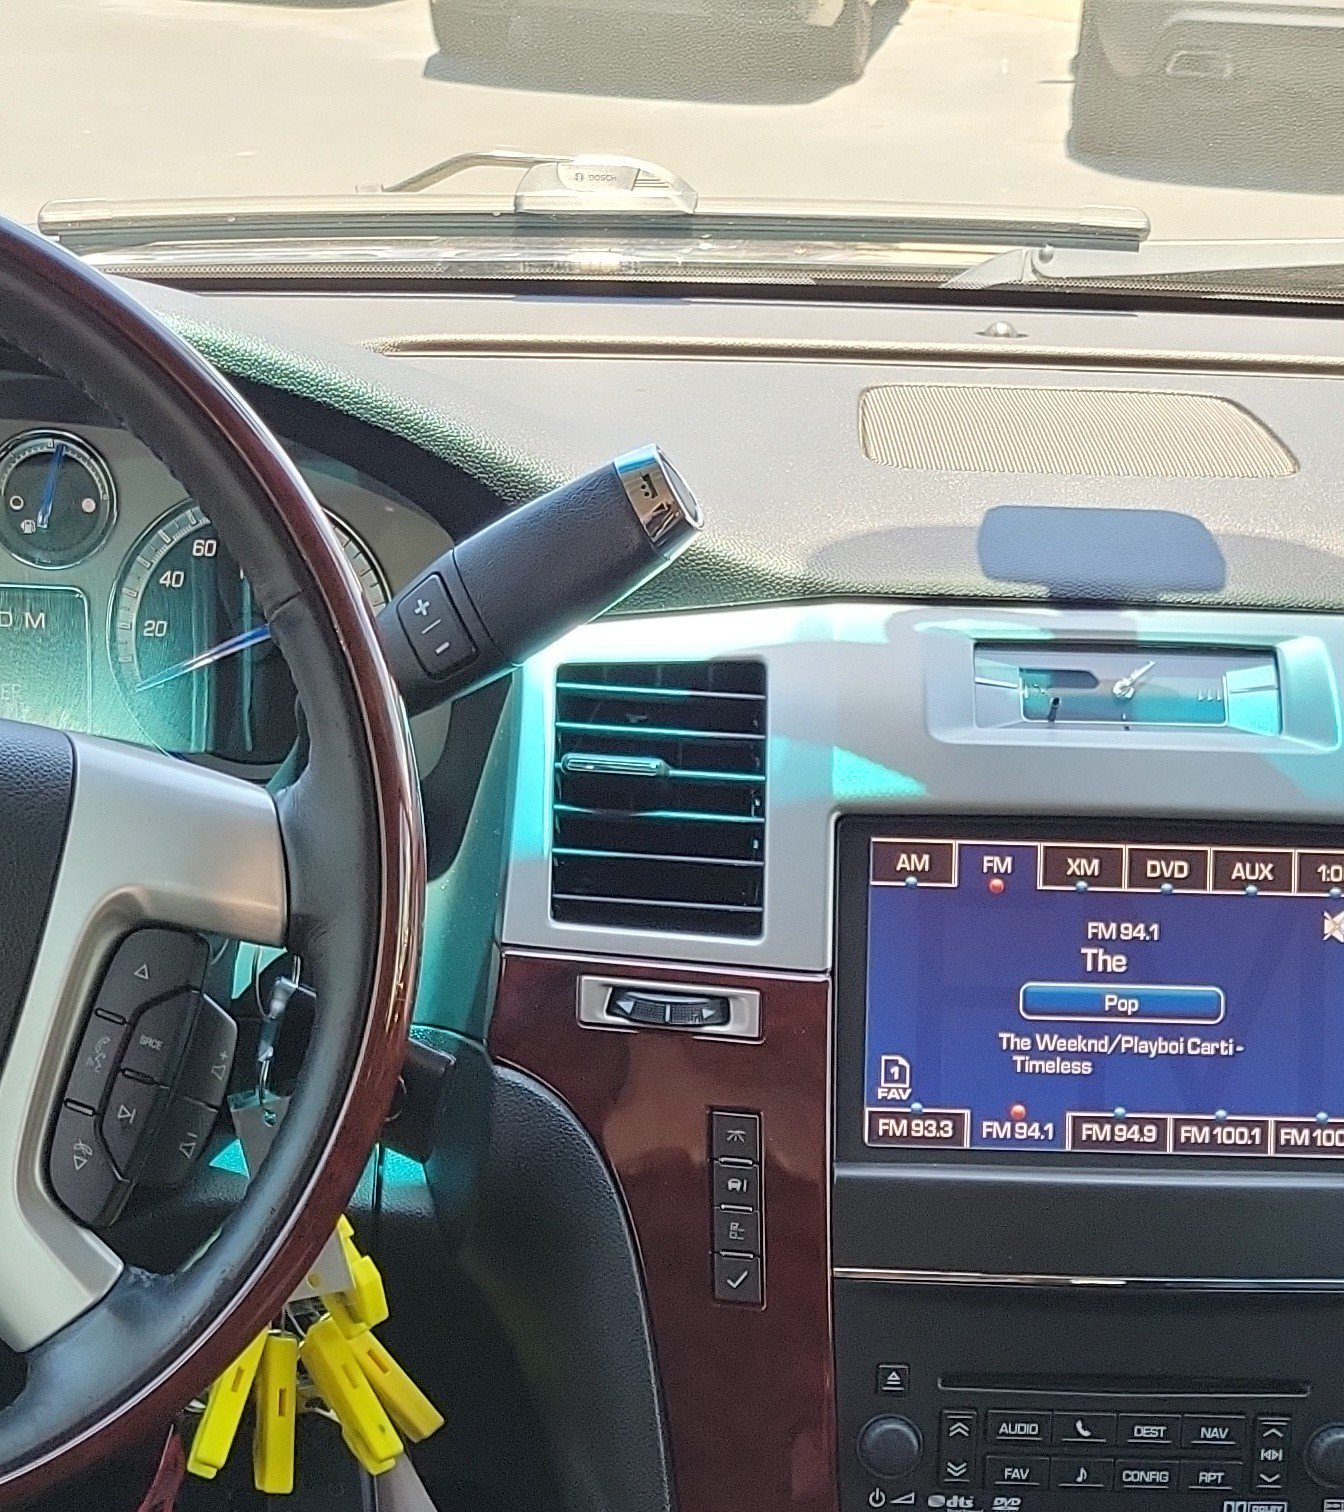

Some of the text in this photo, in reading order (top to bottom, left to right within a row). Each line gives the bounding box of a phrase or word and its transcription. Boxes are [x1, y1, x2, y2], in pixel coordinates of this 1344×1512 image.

[192, 539, 217, 557] 60
[159, 570, 185, 588] 40
[25, 612, 45, 629] M
[143, 620, 168, 637] 20
[896, 853, 930, 872] AM
[983, 856, 1013, 874] FM
[1066, 858, 1100, 876] XM
[1147, 860, 1189, 879] DVD
[1231, 862, 1274, 881] AUX
[1087, 922, 1160, 941] FM 94.1
[1081, 948, 1128, 972] The
[1105, 994, 1138, 1015] Pop
[999, 1032, 1032, 1051] The
[1035, 1033, 1184, 1058] Weeknd/Playboi
[1187, 1037, 1234, 1056] Carti
[890, 1066, 900, 1080] 1
[1013, 1056, 1093, 1075] Timeless
[877, 1088, 912, 1100] FAV
[878, 1119, 953, 1138] FM 93.3
[982, 1121, 1054, 1141] FM 94.1
[1081, 1123, 1157, 1143] FM 94.9
[1180, 1126, 1262, 1145] FM 100.1
[1280, 1128, 1310, 1146] FM
[998, 1422, 1039, 1435] AUDIO
[1134, 1425, 1167, 1438] DEST
[1200, 1427, 1229, 1439] NAV
[1004, 1468, 1030, 1480] FAV
[1122, 1470, 1169, 1483] CONFIG
[1199, 1472, 1225, 1484] RPT
[946, 1495, 974, 1508] dts
[992, 1497, 1022, 1508] DVD
